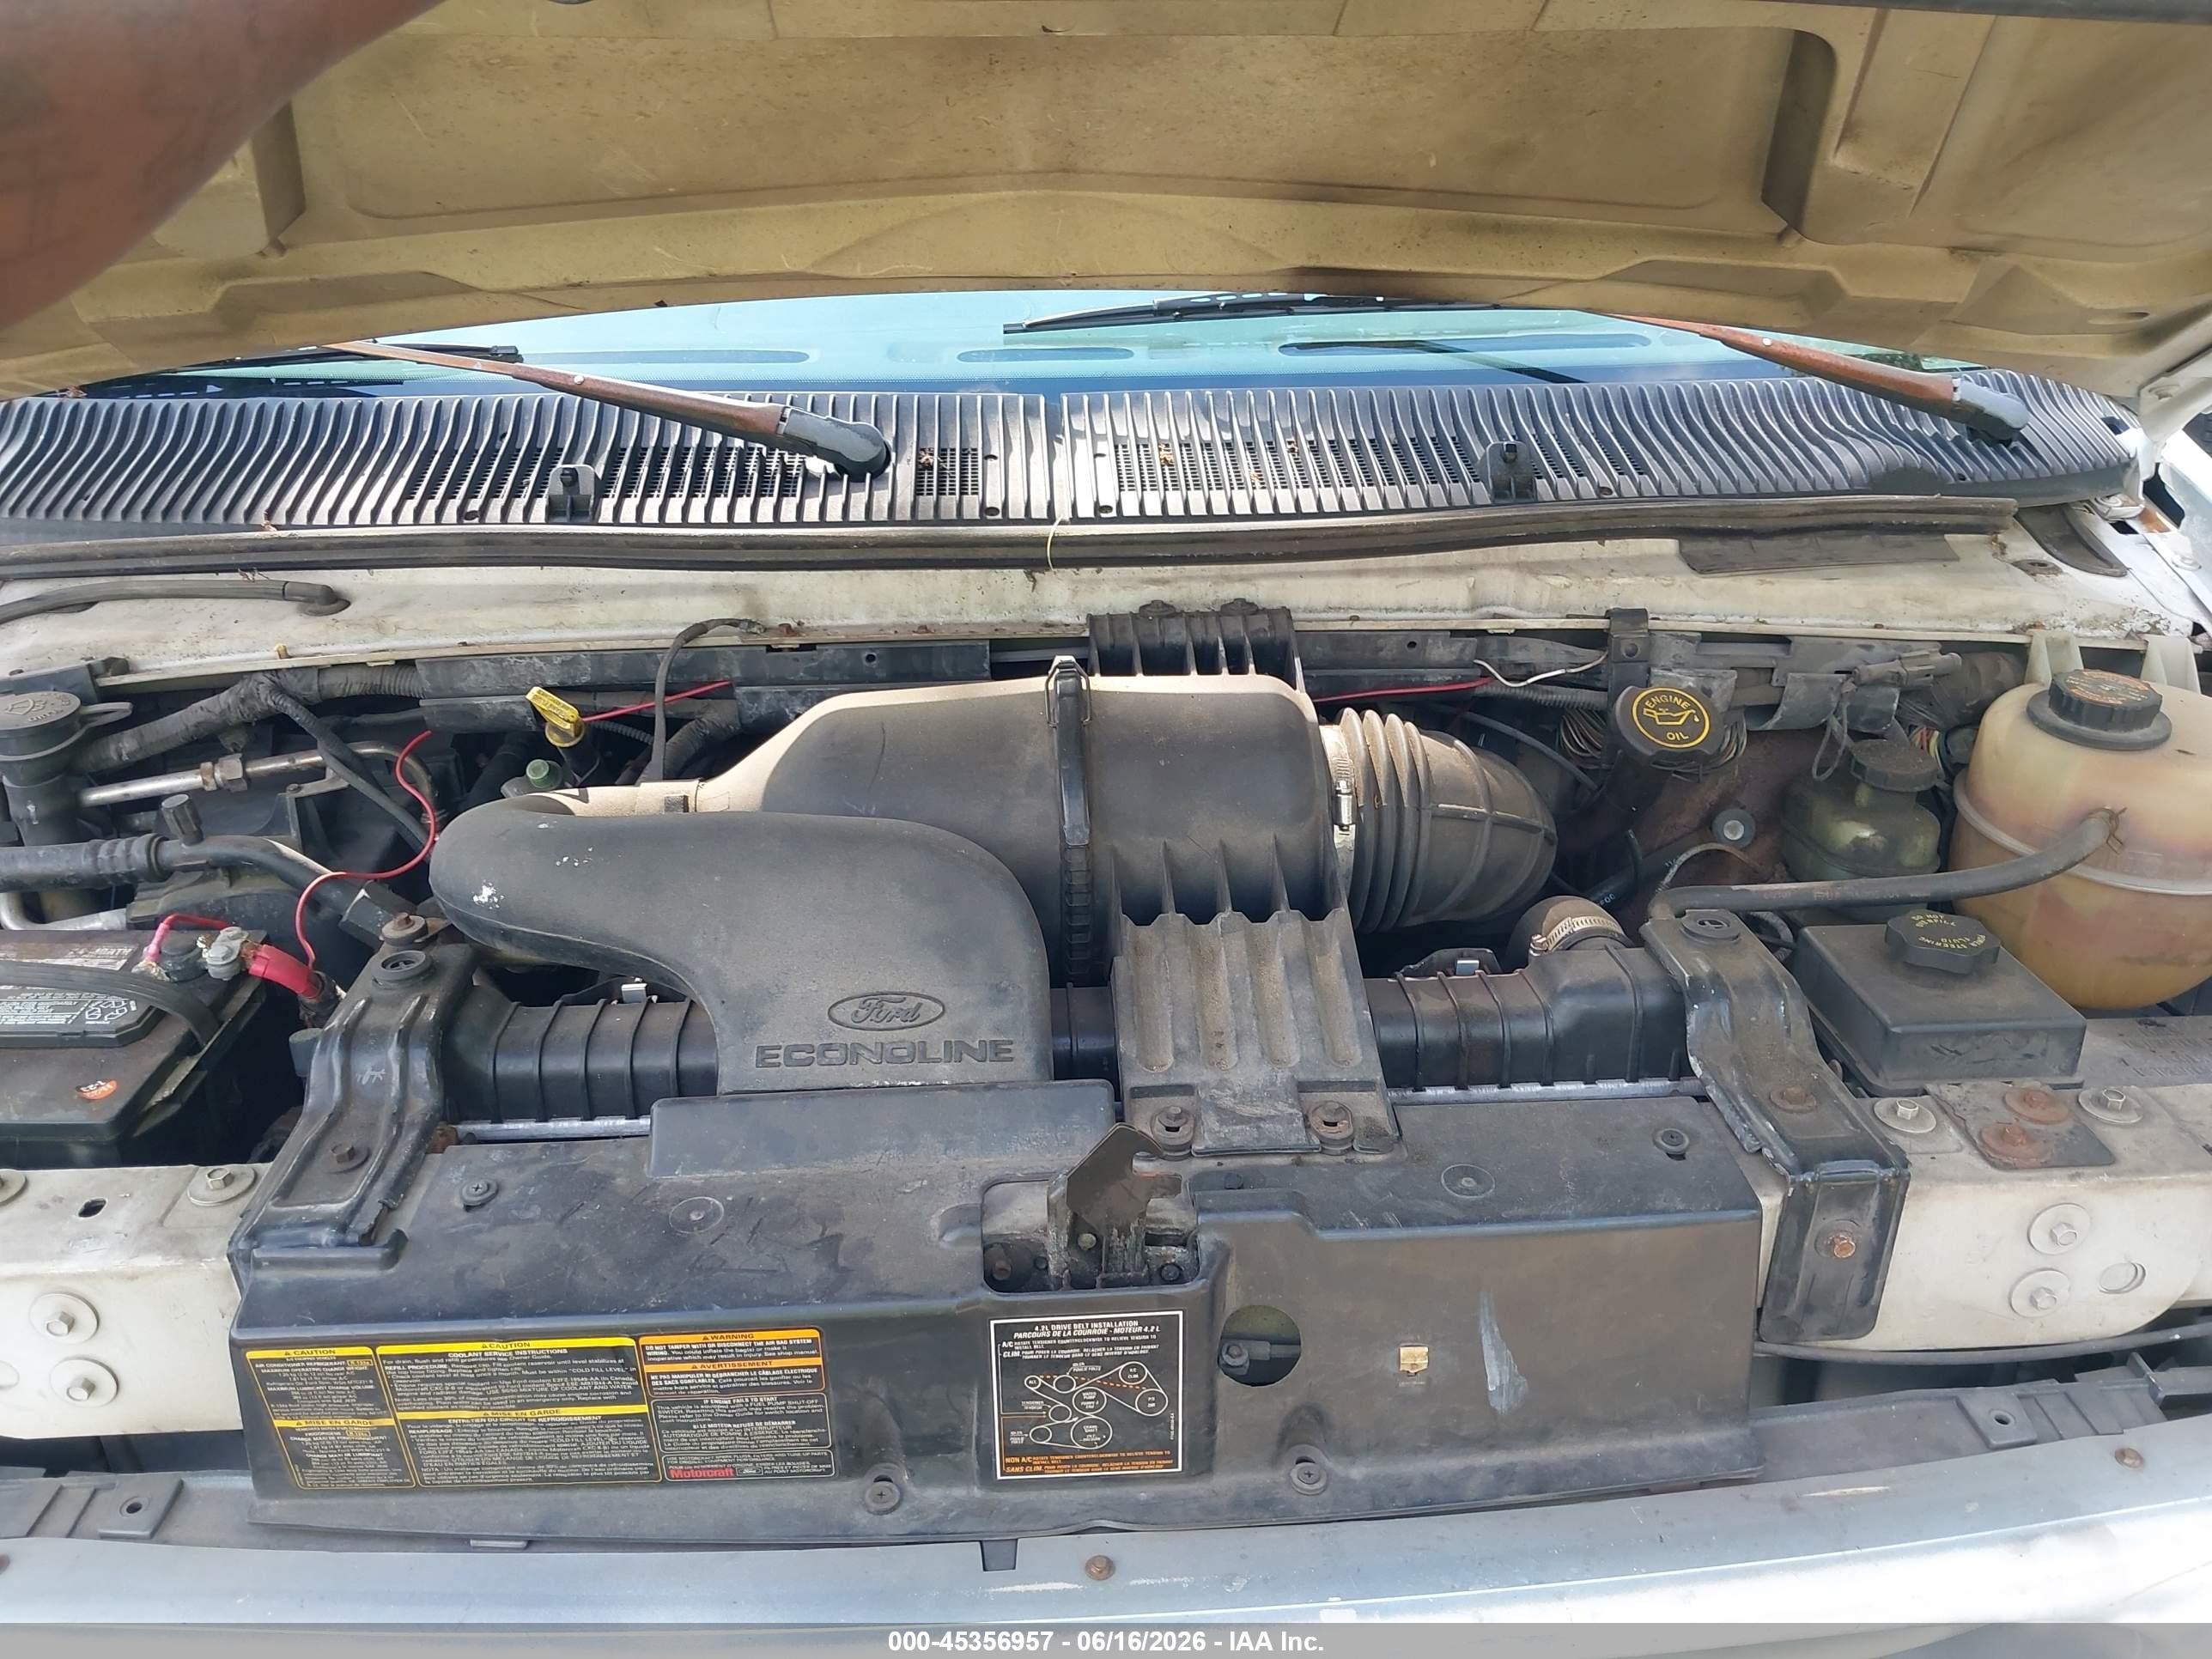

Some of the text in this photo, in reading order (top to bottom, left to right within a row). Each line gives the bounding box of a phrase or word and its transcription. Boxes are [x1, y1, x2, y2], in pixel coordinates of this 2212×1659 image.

[1644, 696, 1691, 709] ENGINE
[1667, 732, 1689, 740] OIL
[852, 996, 921, 1023] Ford
[755, 1039, 1015, 1068] ECONOLINE
[1091, 1321, 1138, 1329] INSTALLATION
[672, 1468, 734, 1479] Motorcraft
